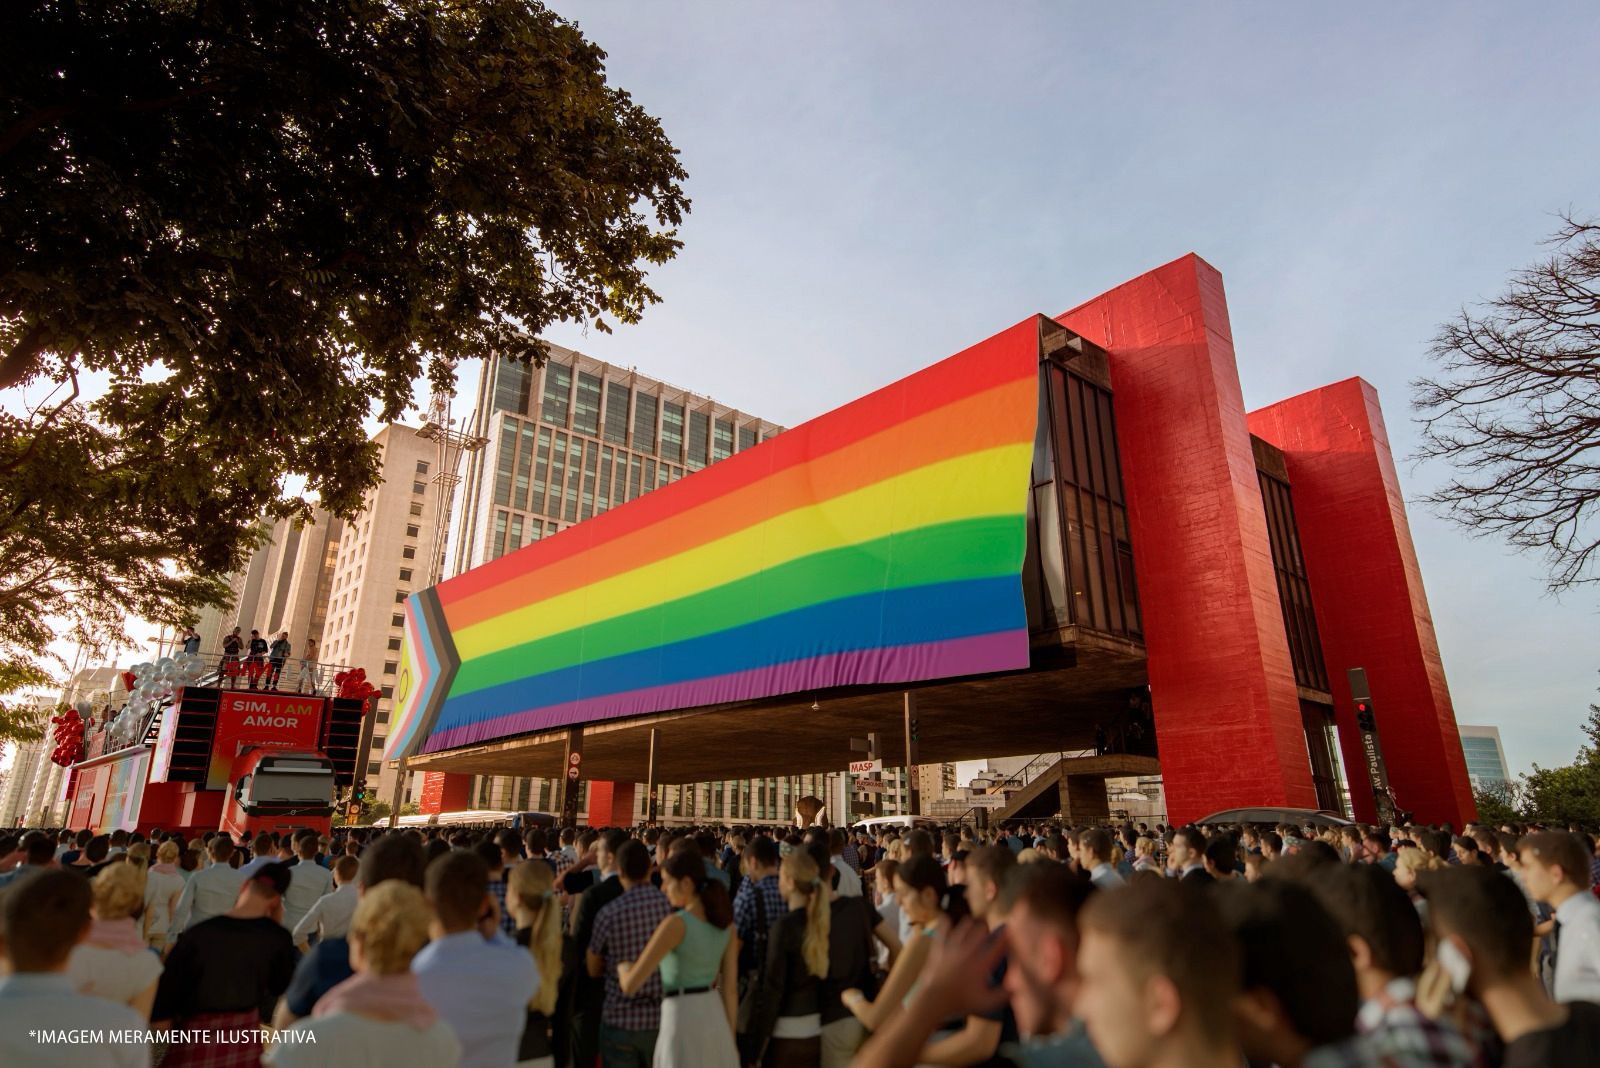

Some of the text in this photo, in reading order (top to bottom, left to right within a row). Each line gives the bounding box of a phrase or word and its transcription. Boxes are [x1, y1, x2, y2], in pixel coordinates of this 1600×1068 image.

[233, 701, 270, 714] SIM,
[275, 704, 280, 713] I
[285, 704, 312, 715] AM
[243, 716, 297, 728] AMOR
[1364, 734, 1380, 774] Paulista
[851, 762, 873, 773] MASP
